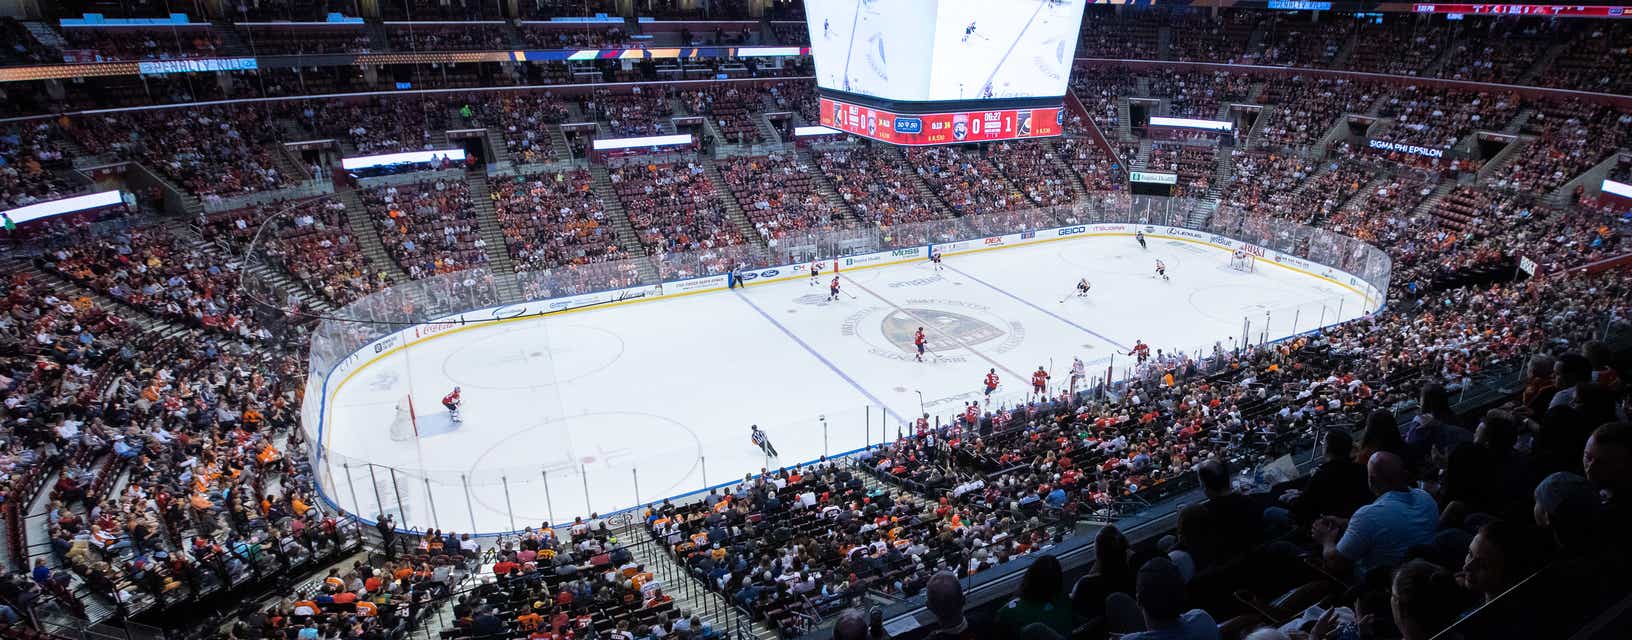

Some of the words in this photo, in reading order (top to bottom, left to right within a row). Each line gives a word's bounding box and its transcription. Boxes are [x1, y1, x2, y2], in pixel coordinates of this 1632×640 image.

[153, 60, 209, 73] PENALTY
[861, 114, 866, 129] 0
[984, 112, 1001, 122] 06:27
[1005, 116, 1011, 132] 1
[972, 118, 980, 134] 0
[1369, 139, 1393, 150] SIGMA
[1395, 143, 1407, 152] PHI
[1409, 145, 1443, 158] EPSILON
[1058, 226, 1086, 236] GEICO
[1209, 236, 1232, 247] jetBlue
